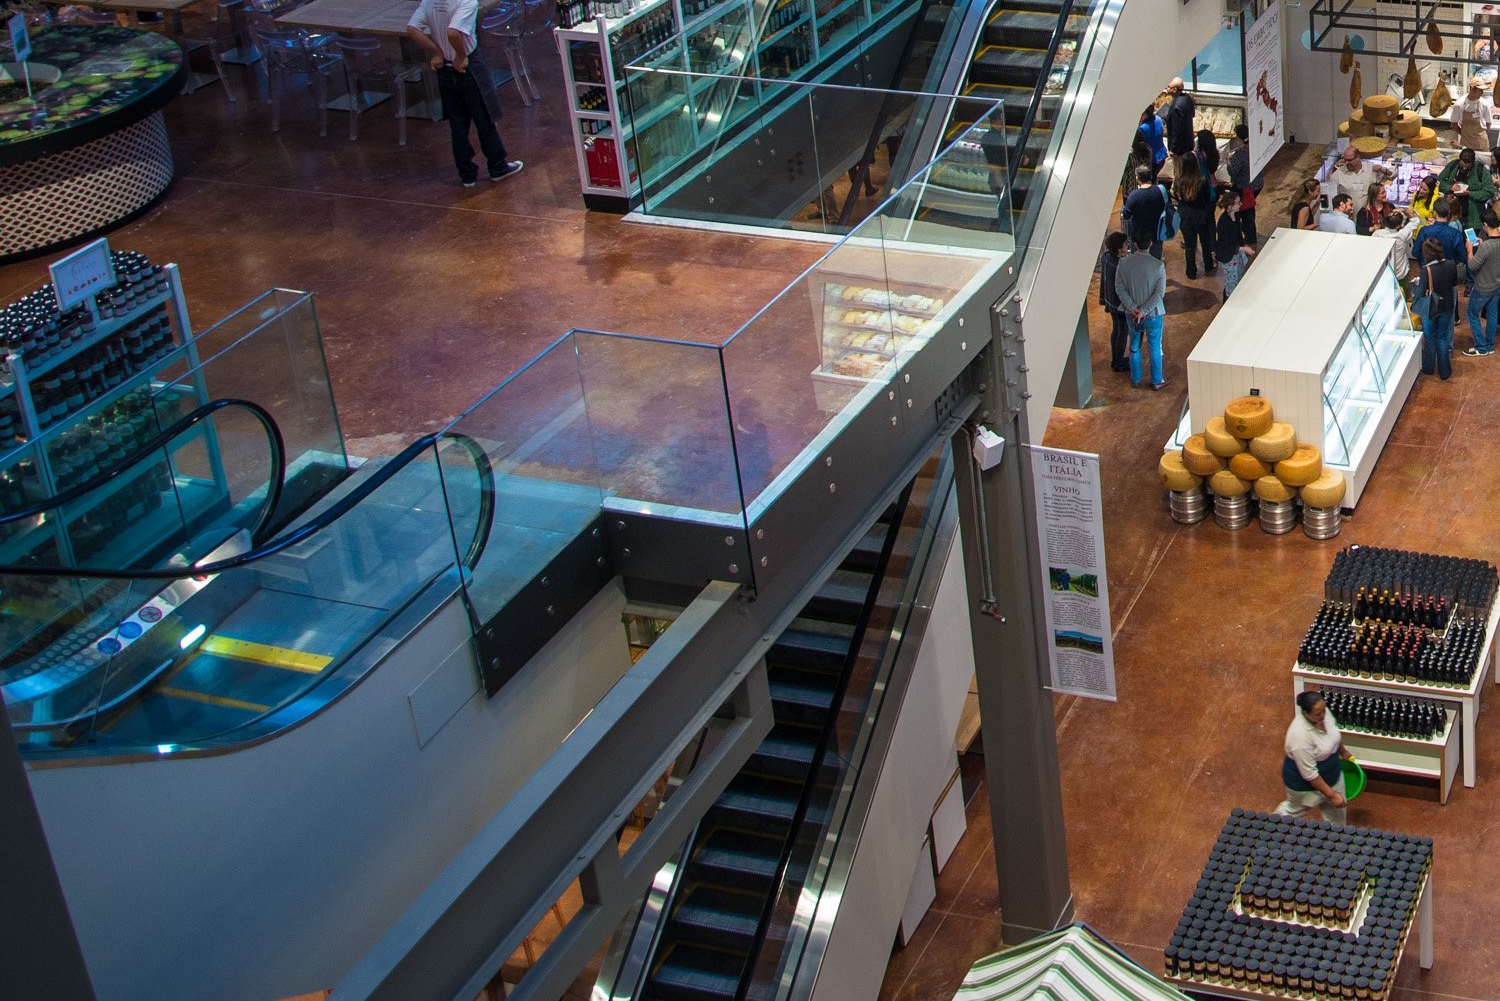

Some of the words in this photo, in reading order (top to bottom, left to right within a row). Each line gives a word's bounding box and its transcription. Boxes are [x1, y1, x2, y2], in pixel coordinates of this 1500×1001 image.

[1043, 453, 1079, 466] BRASIL
[1081, 458, 1088, 467] E
[1053, 485, 1081, 496] VINHO
